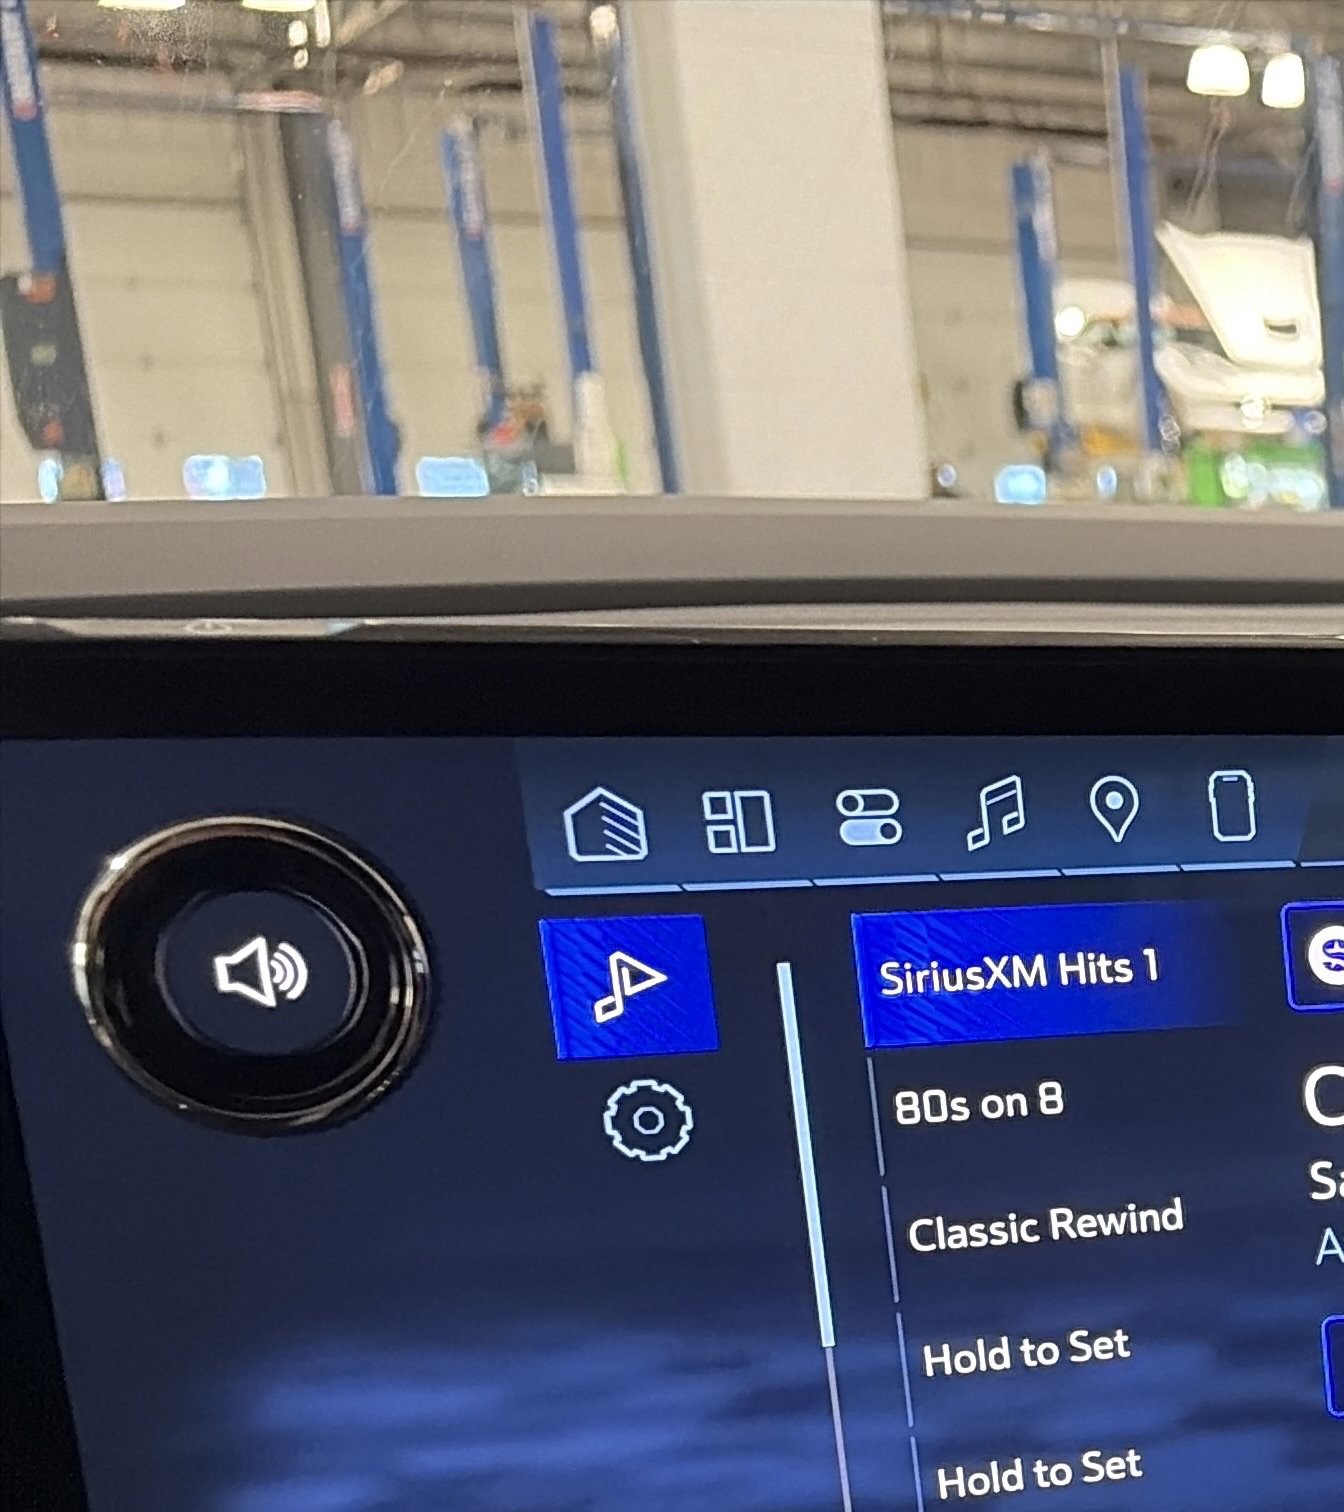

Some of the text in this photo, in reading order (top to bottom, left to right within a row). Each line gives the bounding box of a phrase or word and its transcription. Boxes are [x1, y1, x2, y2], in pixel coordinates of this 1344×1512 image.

[879, 948, 1159, 996] SiriusXM Hits 1
[895, 1081, 1065, 1125] 80s on 8
[909, 1197, 1184, 1252] Classic Rewind
[923, 1328, 1131, 1377] Hold to Set
[937, 1449, 1143, 1500] Hold to Set
